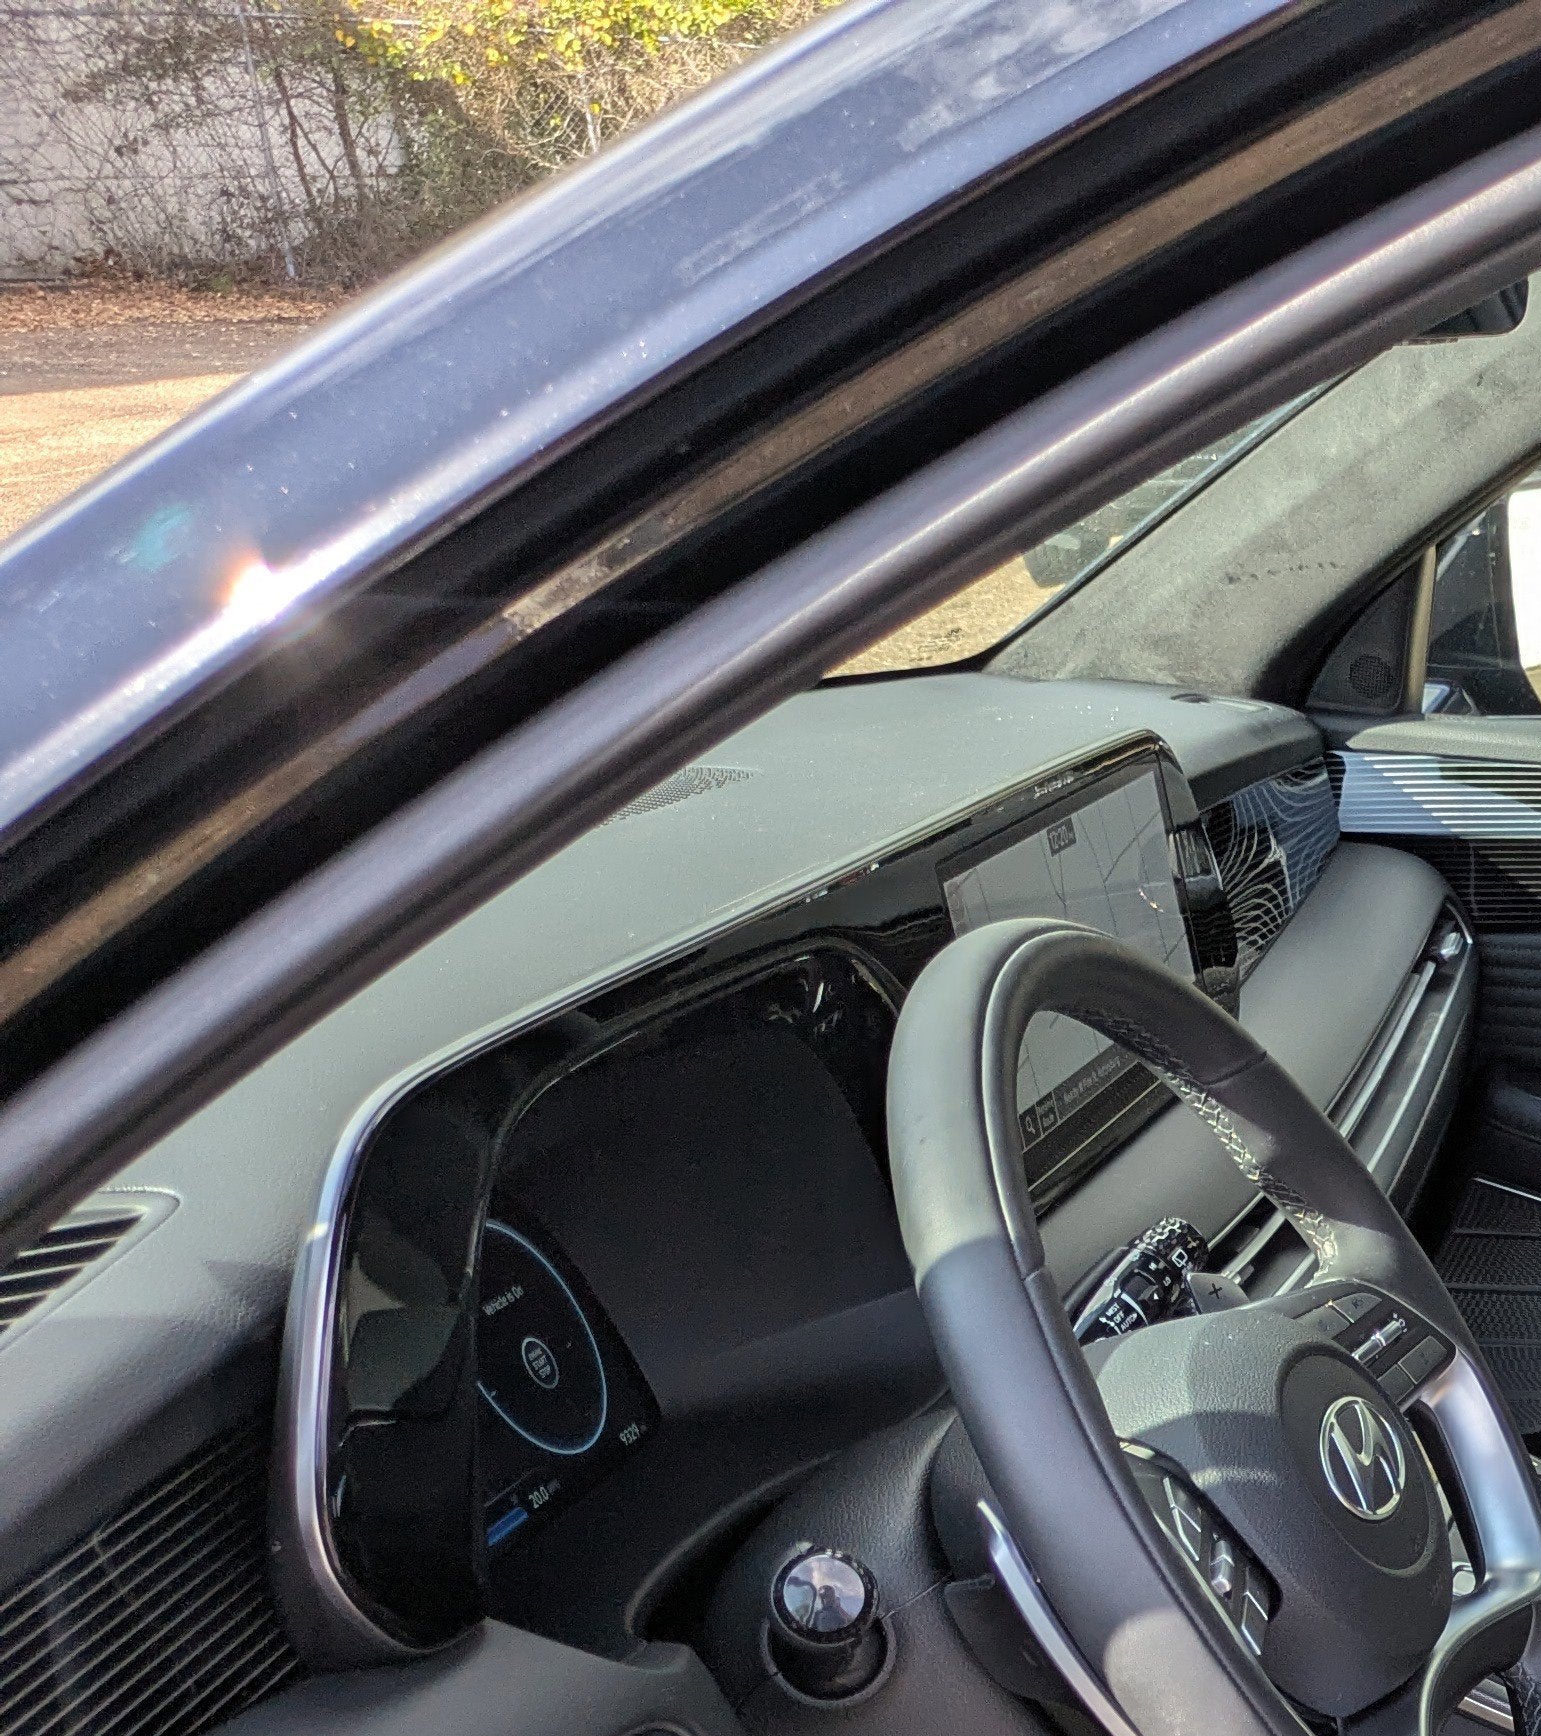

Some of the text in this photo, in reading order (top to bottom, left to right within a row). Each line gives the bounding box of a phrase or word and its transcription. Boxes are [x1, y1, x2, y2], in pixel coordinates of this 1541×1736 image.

[1105, 1302, 1120, 1317] MIST
[1113, 1310, 1125, 1323] OFF
[1120, 1312, 1138, 1331] AUTO
[528, 1486, 550, 1508] 20.0
